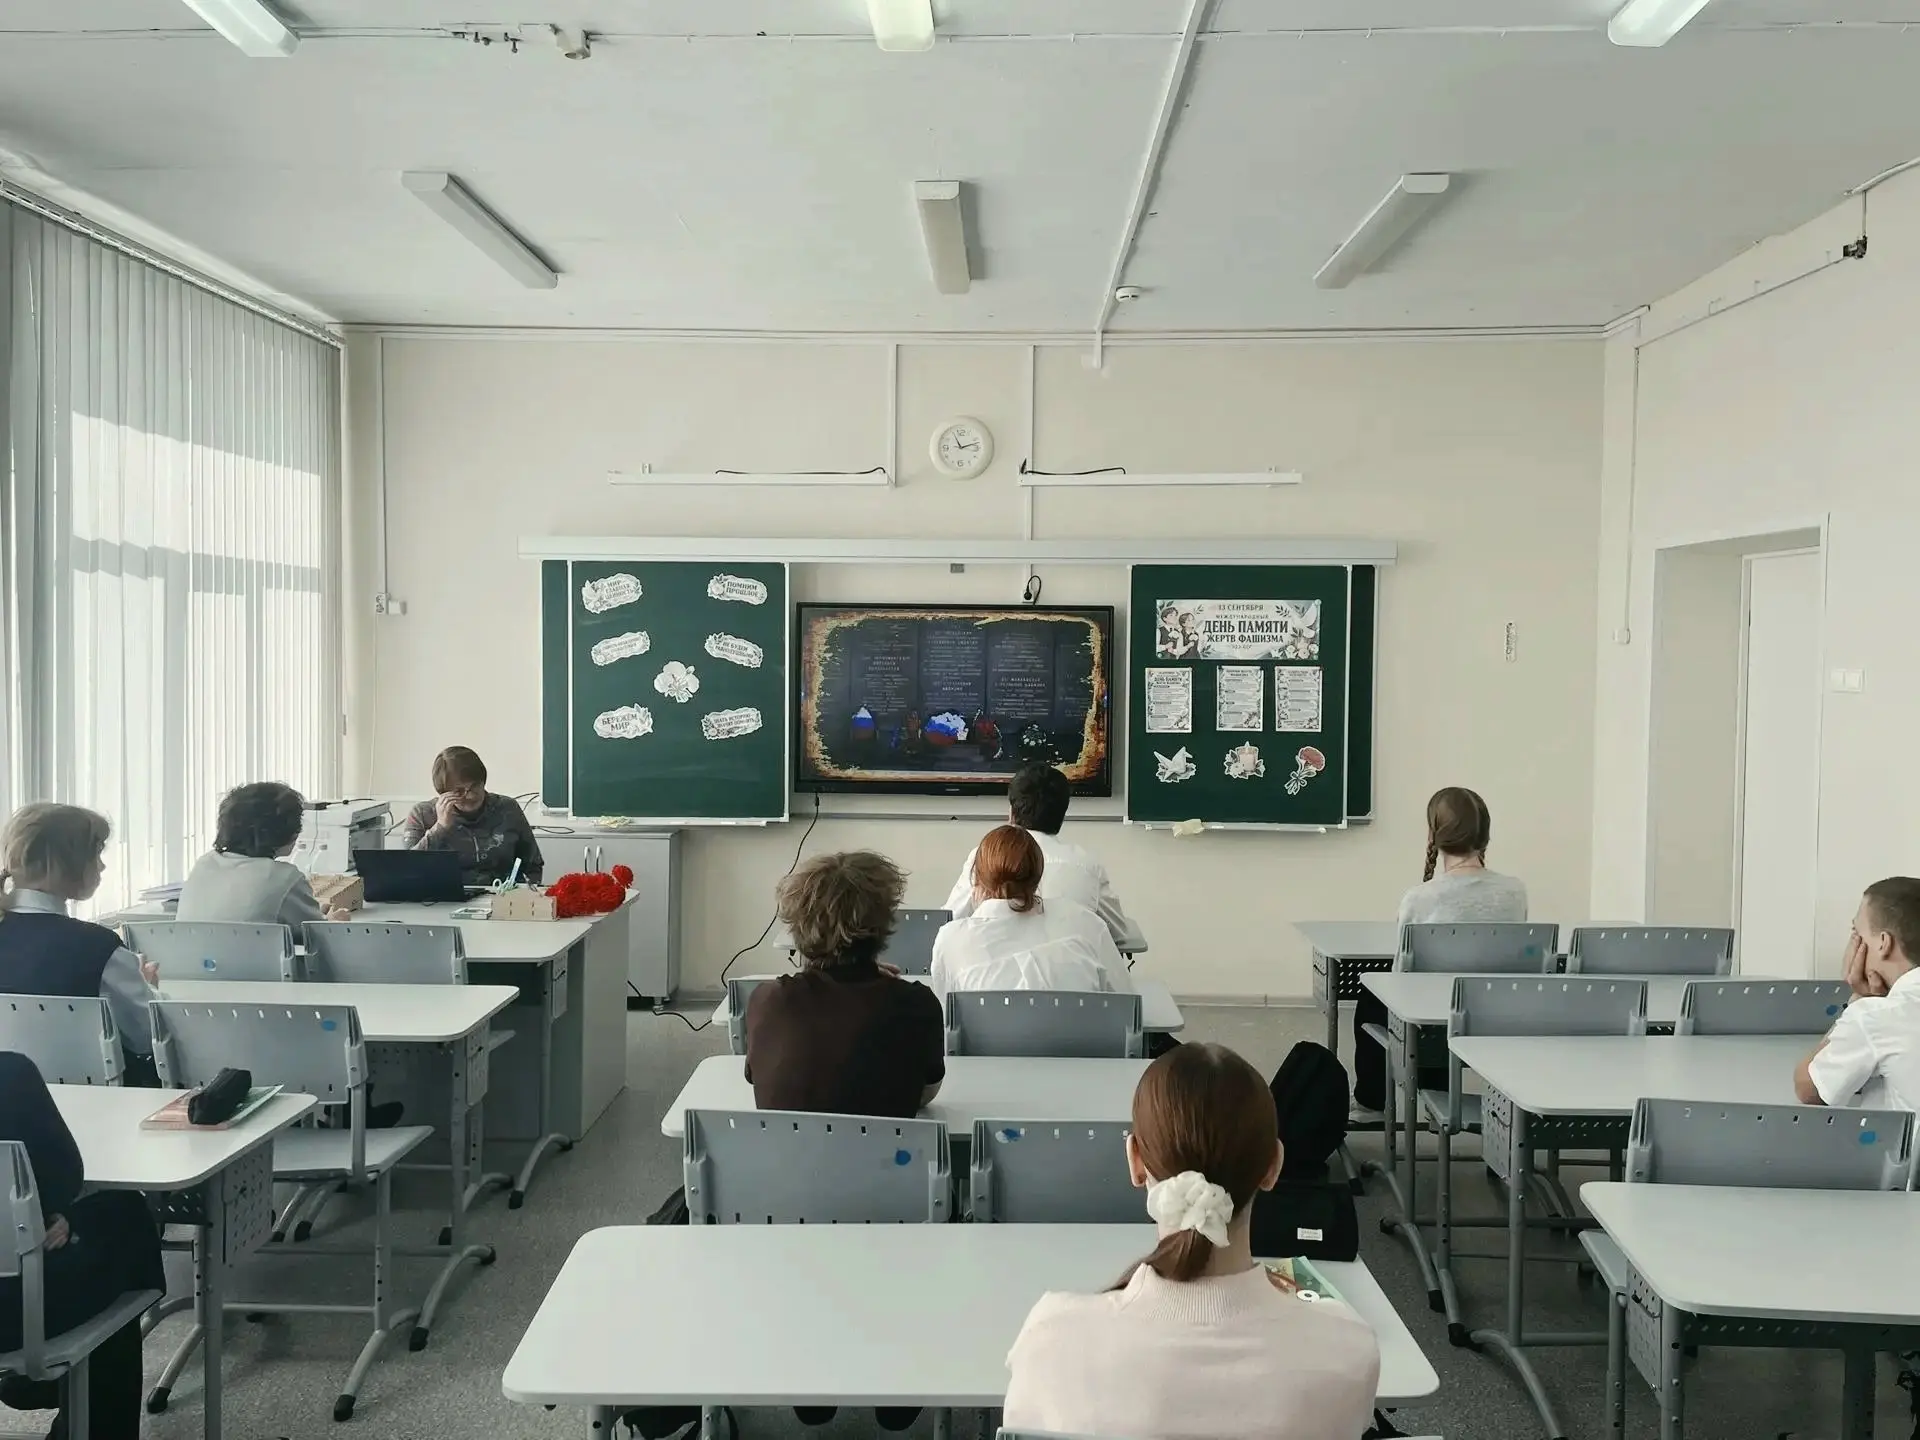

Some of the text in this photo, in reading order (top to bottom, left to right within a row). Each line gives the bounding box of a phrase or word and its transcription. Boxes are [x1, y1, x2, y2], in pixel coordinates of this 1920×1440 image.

[957, 429, 966, 437] 12
[957, 459, 964, 467] 6
[607, 579, 621, 587] МИР
[727, 581, 758, 590] ПОМНИМ
[726, 587, 759, 597] ПРОШЛОЕ
[1203, 620, 1289, 635] ДЕНЬ ПАМЯТИ
[1206, 634, 1284, 643] ЖЕРТВ ФАШИЗМА
[611, 722, 630, 731] МИР
